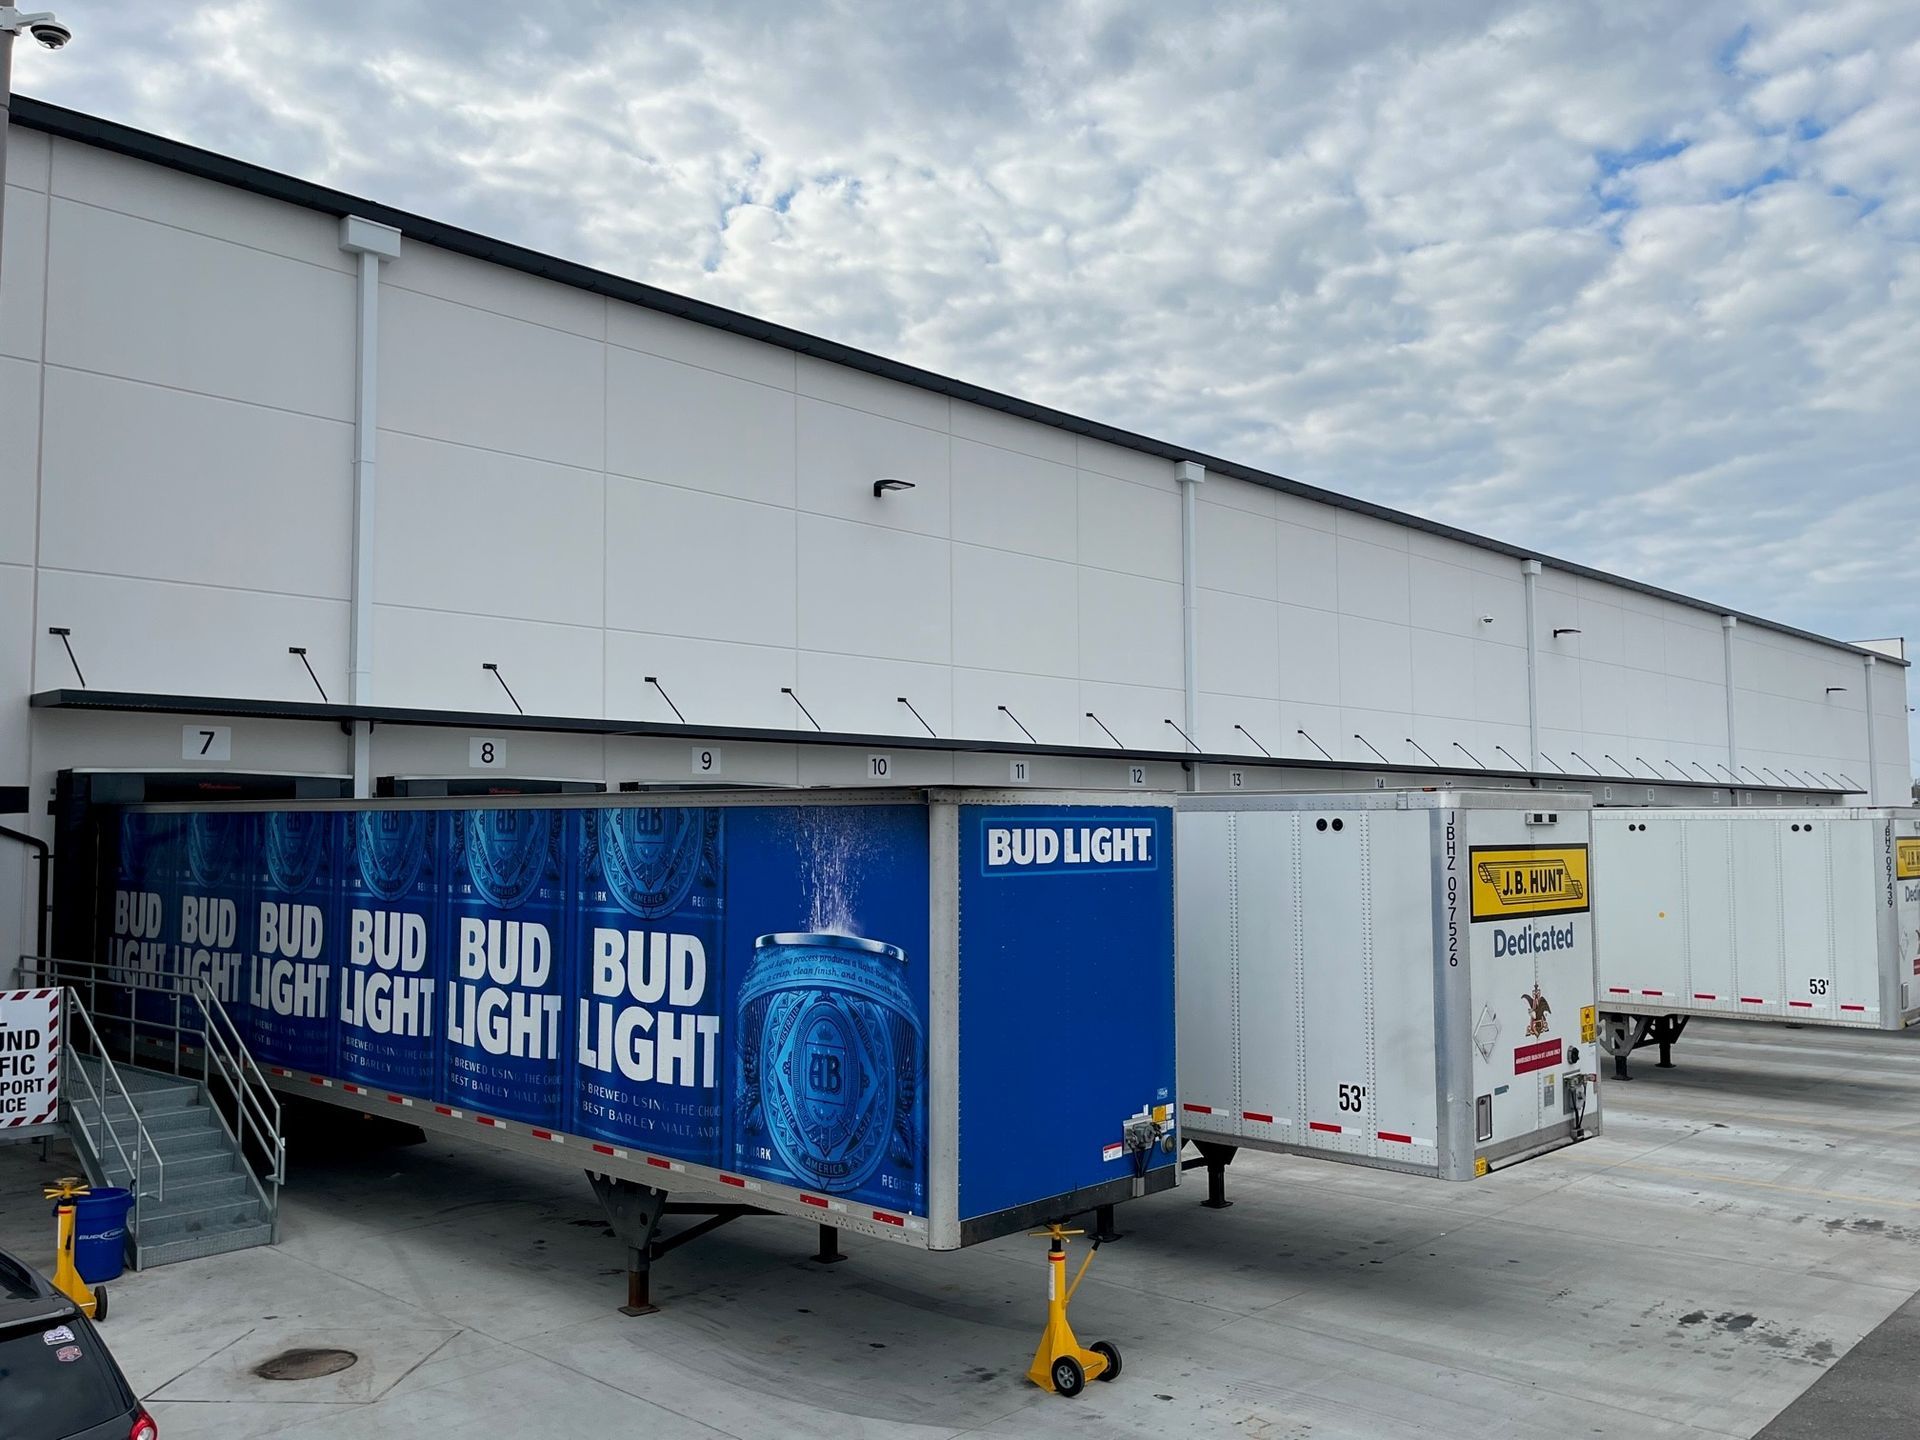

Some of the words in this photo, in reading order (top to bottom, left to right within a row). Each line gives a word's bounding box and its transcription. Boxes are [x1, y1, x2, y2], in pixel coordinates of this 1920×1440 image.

[199, 730, 216, 755] 7
[481, 742, 495, 764] 8
[700, 752, 712, 771] 9
[871, 758, 887, 776] 10
[1015, 763, 1025, 779] 11
[1131, 768, 1143, 784] 12
[1231, 773, 1242, 787] 13
[988, 828, 1059, 866] BUD
[1064, 827, 1152, 864] LIGHT
[1446, 811, 1456, 871] JBHZ
[1503, 871, 1527, 895] J.B.
[1530, 868, 1564, 893] HUNT
[115, 890, 162, 938] BUD
[181, 895, 236, 948] BUD
[259, 901, 323, 959] BUD
[1447, 876, 1458, 967] 097526
[350, 908, 427, 973] BUD
[459, 917, 551, 987] BUD
[1494, 921, 1574, 958] Dedicated
[173, 945, 242, 1002] LIGHT
[592, 927, 706, 1007] BUD
[793, 954, 819, 965] process
[819, 953, 850, 966] produces
[793, 966, 813, 975] clean
[841, 971, 856, 980] and
[251, 955, 330, 1018] LIGHT
[340, 967, 435, 1037] LIGHT
[1809, 978, 1829, 995] 53'
[447, 980, 562, 1059] LIGHT
[578, 998, 720, 1088] LIGHT
[454, 1056, 488, 1075] BREWED
[1, 1078, 44, 1096] PORT
[472, 1080, 510, 1098] BARLEY
[587, 1083, 628, 1104] BREWED
[674, 1102, 695, 1116] THE
[1338, 1084, 1367, 1113] 53'
[582, 1100, 605, 1117] BEST
[608, 1109, 656, 1131] BARLEY
[778, 1094, 797, 1131] AFRICA
[805, 1158, 844, 1174] AMERICA
